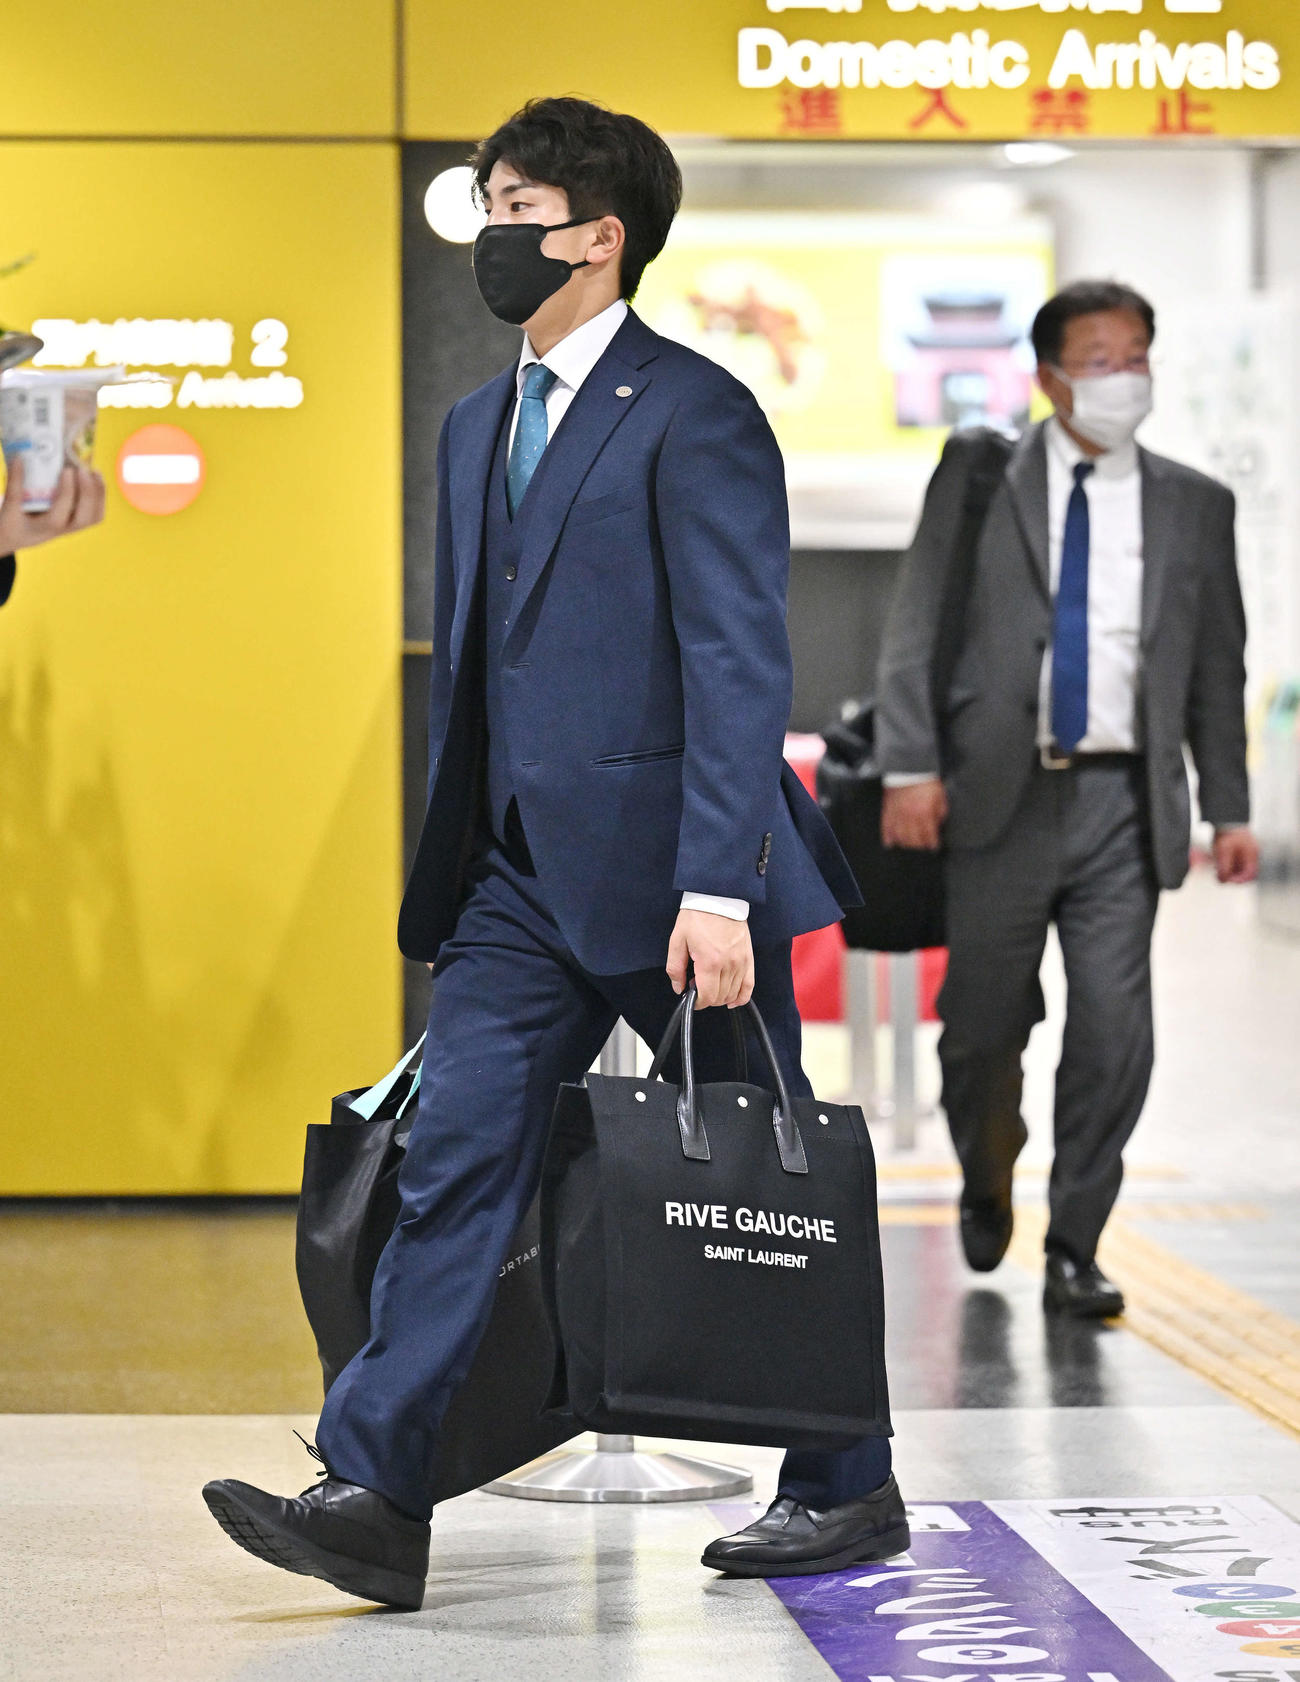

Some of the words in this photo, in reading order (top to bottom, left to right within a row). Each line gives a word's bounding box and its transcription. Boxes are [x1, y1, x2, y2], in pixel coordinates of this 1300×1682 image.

[738, 28, 1031, 89] Domestic
[1047, 28, 1281, 90] Arrivals
[665, 1201, 729, 1229] RIVE
[735, 1207, 837, 1243] GAUCHE
[498, 1243, 540, 1277] RTAB
[704, 1245, 745, 1262] SAINT
[748, 1249, 809, 1269] LAURENT
[1100, 1534, 1273, 1580] バス
